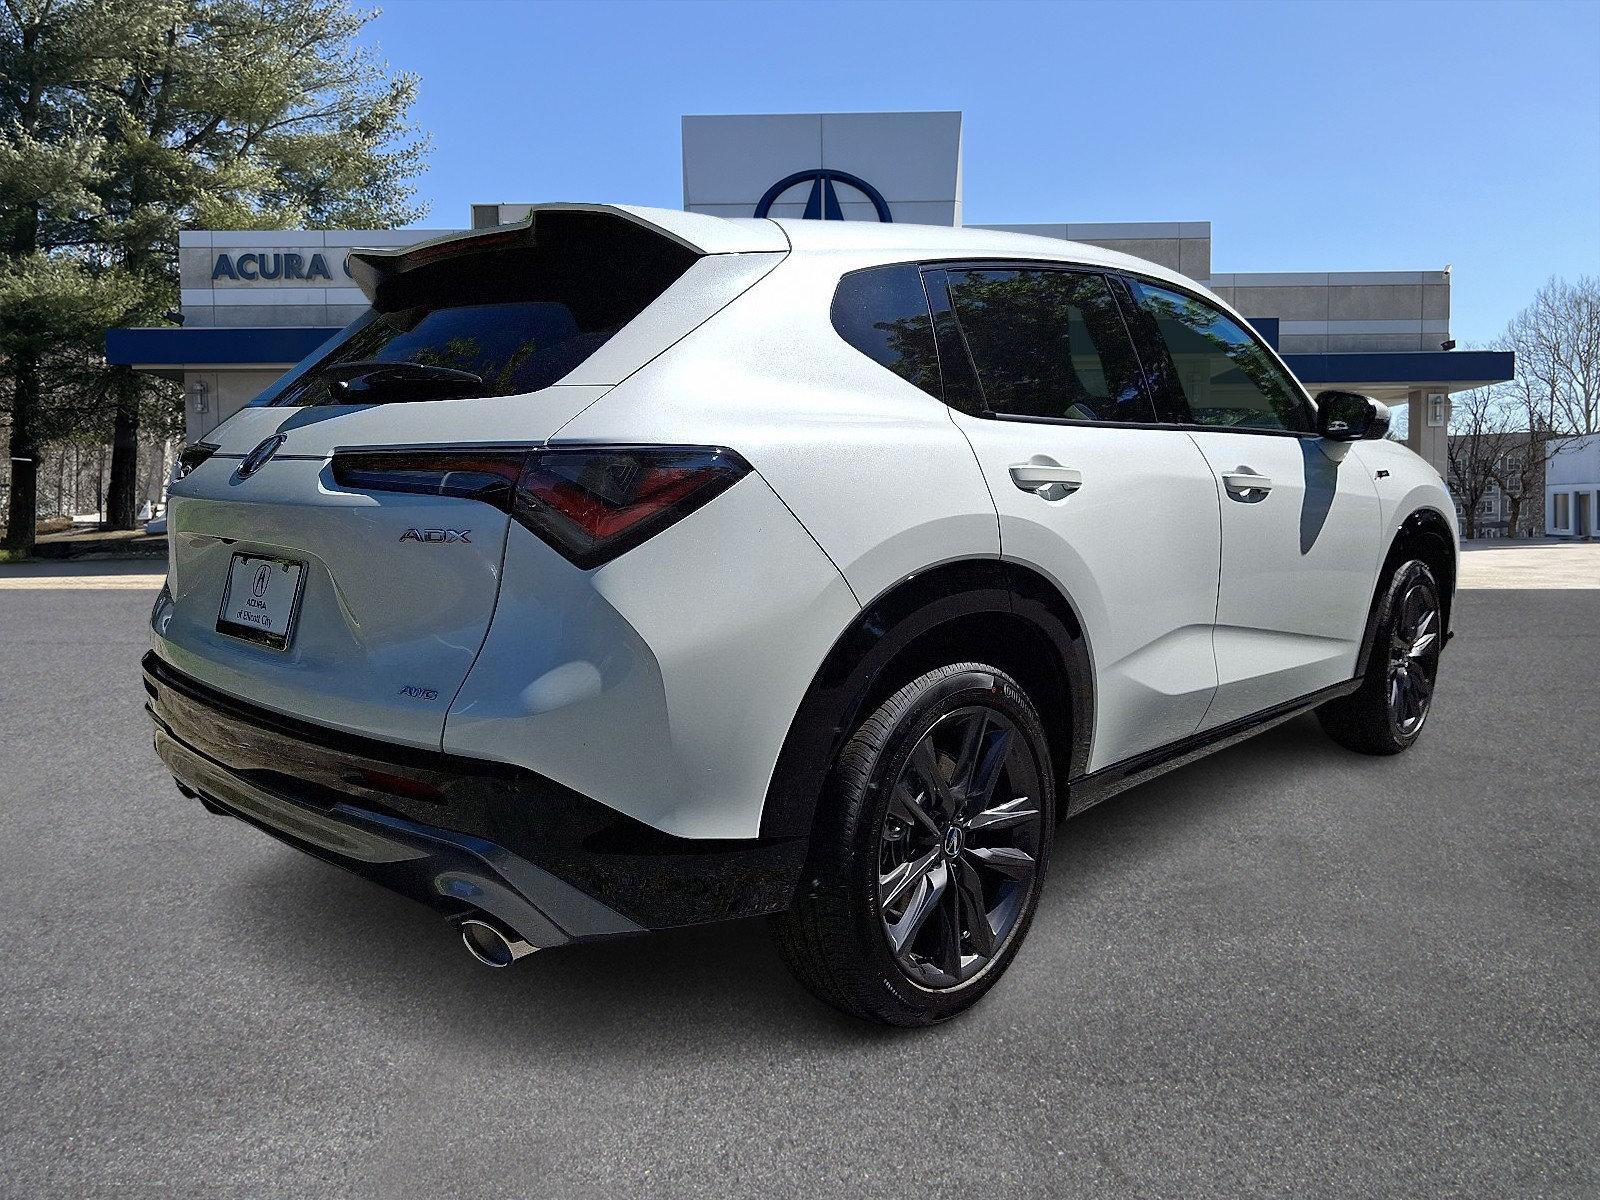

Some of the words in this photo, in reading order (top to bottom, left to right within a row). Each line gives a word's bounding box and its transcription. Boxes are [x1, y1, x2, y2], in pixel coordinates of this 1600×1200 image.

[211, 253, 332, 281] ACURA
[398, 528, 473, 544] ADX
[245, 598, 267, 610] ACURA
[398, 685, 439, 701] AWD
